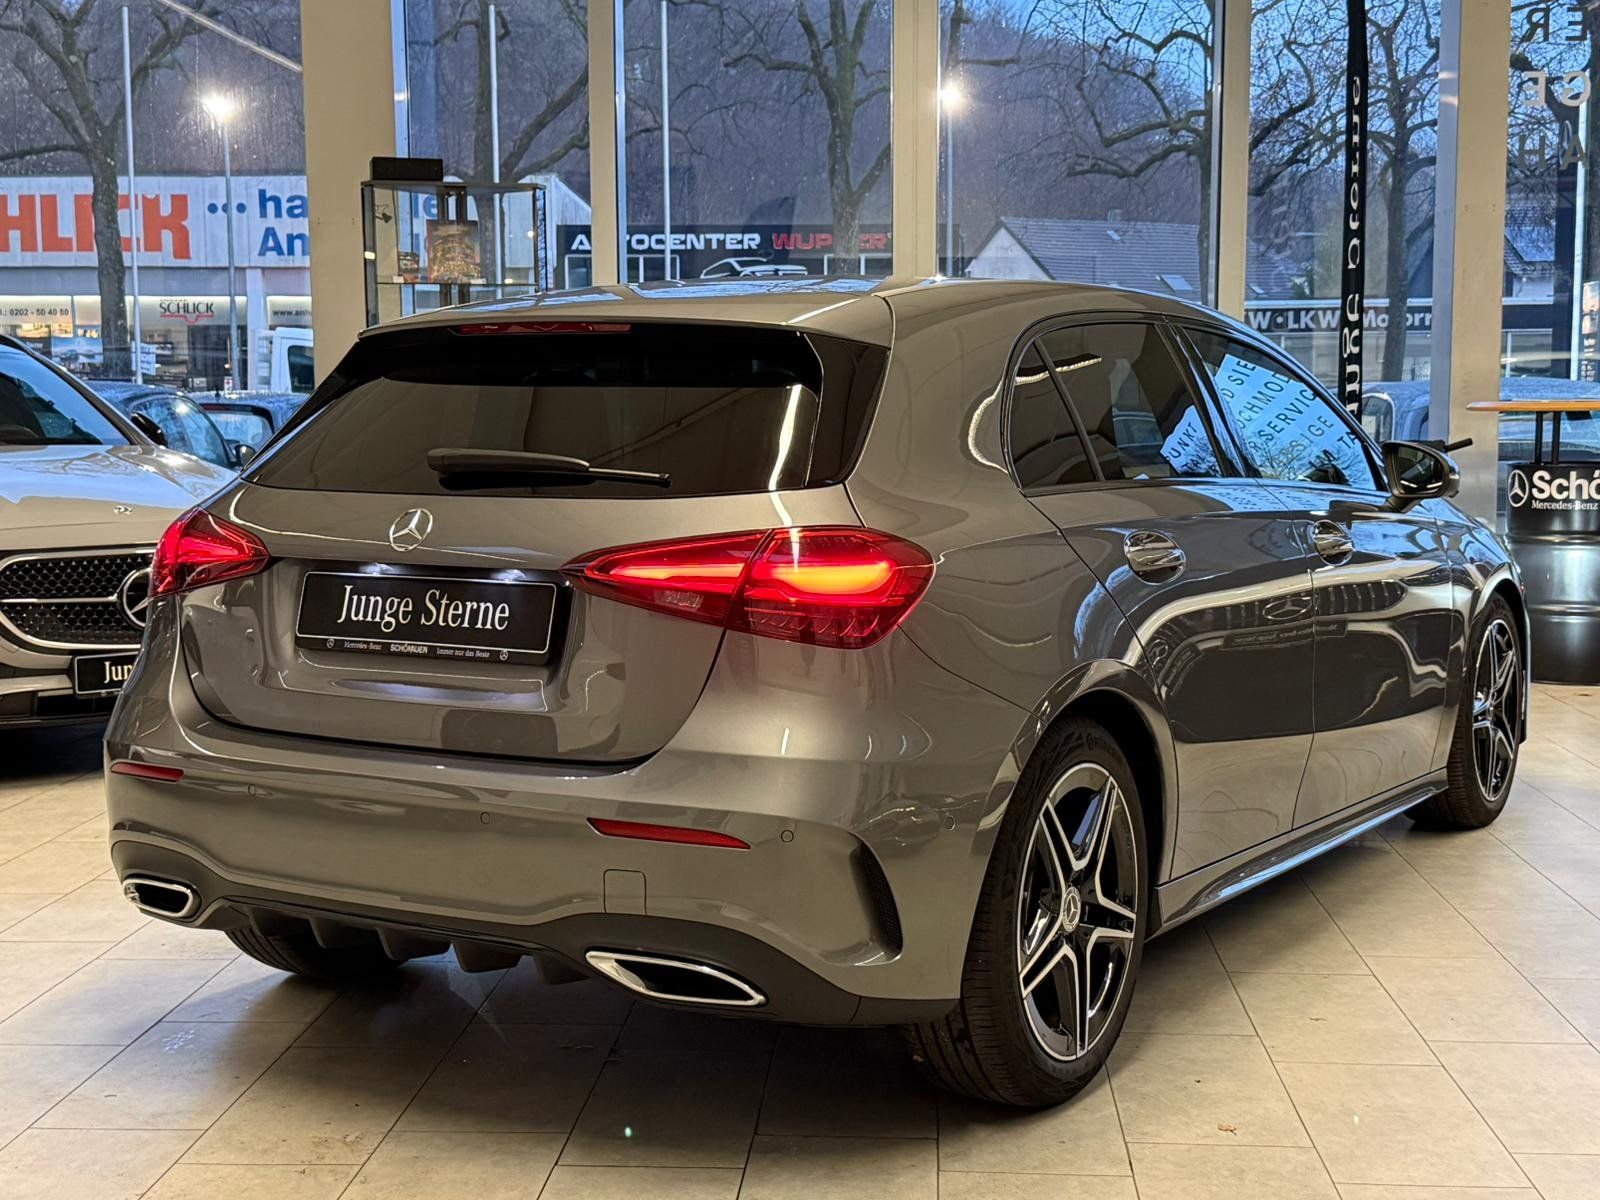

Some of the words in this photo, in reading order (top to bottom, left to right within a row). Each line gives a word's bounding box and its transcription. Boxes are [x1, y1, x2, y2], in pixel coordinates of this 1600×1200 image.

[571, 233, 761, 250] AOCENTER
[772, 233, 891, 249] WUPER
[159, 302, 215, 314] SCHLICK
[1532, 500, 1599, 511] Mercedes-Benz
[337, 585, 413, 633] Junge
[420, 589, 510, 630] Sterne
